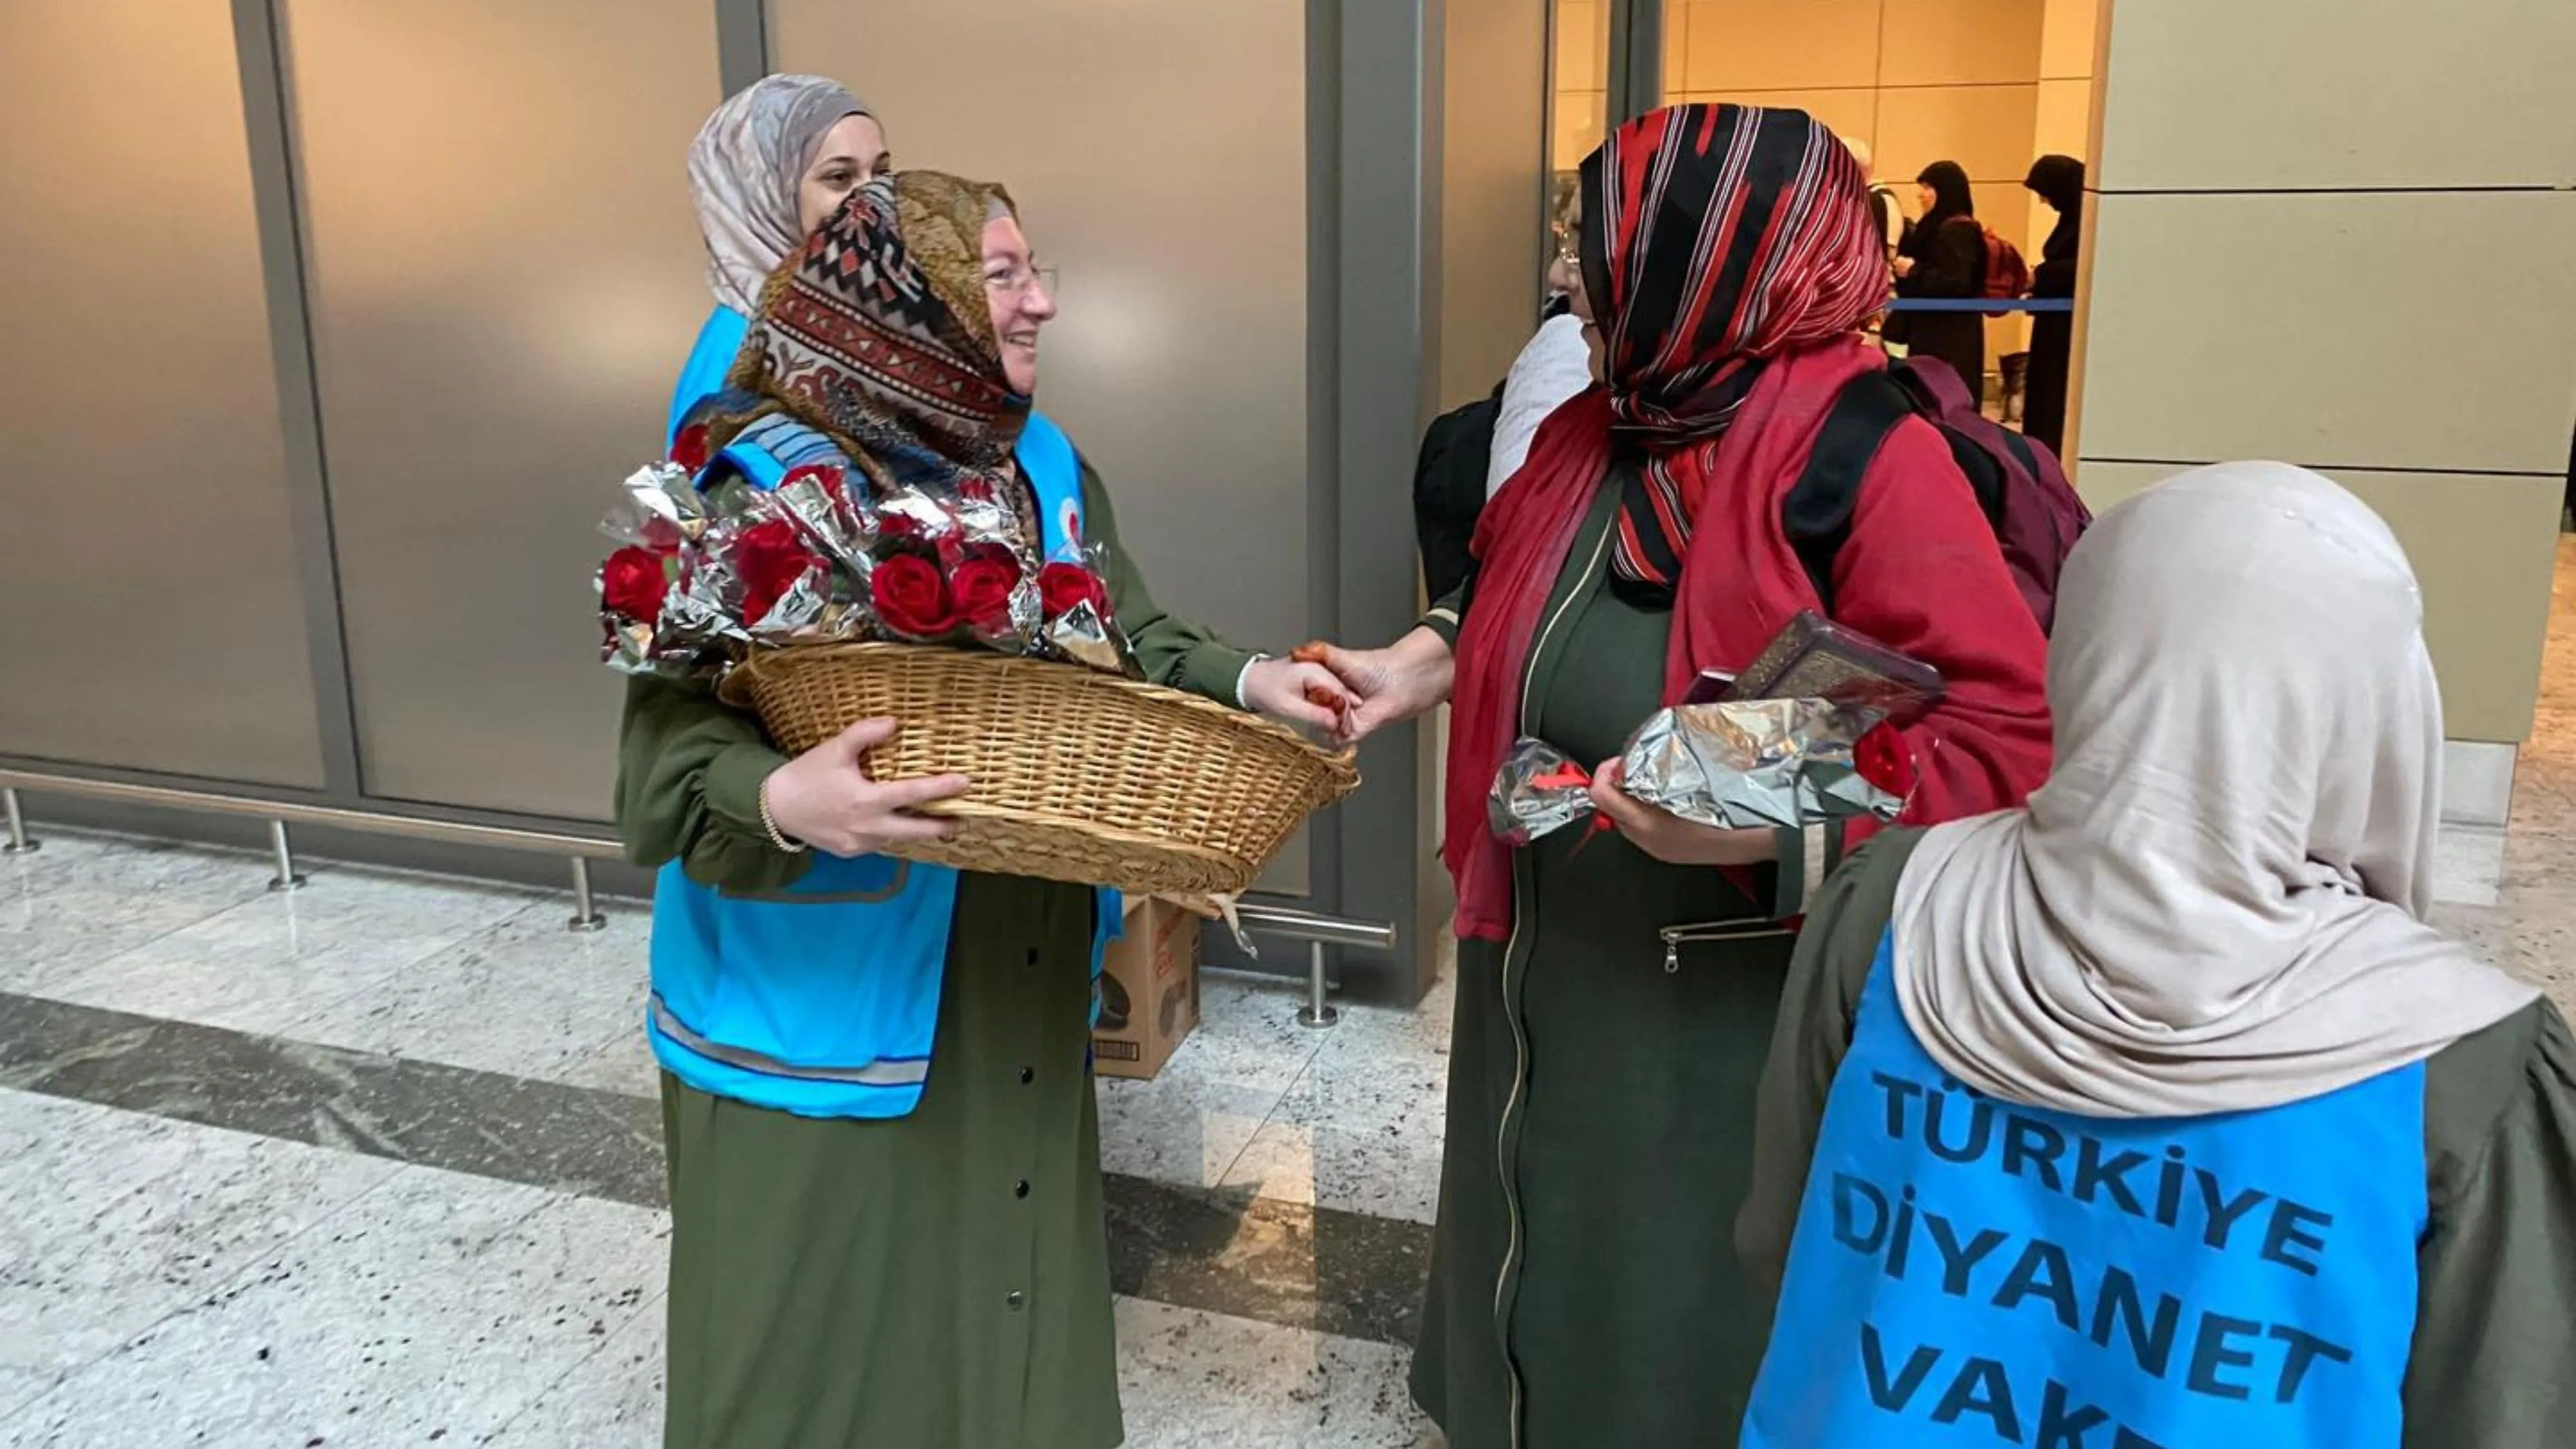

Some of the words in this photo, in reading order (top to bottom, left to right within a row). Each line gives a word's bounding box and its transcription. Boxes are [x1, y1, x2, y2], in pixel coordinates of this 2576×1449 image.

[1872, 1070, 2333, 1276] TÜRKİYE
[1833, 1172, 2352, 1403] DİYANET
[1861, 1321, 2166, 1449] VAK
